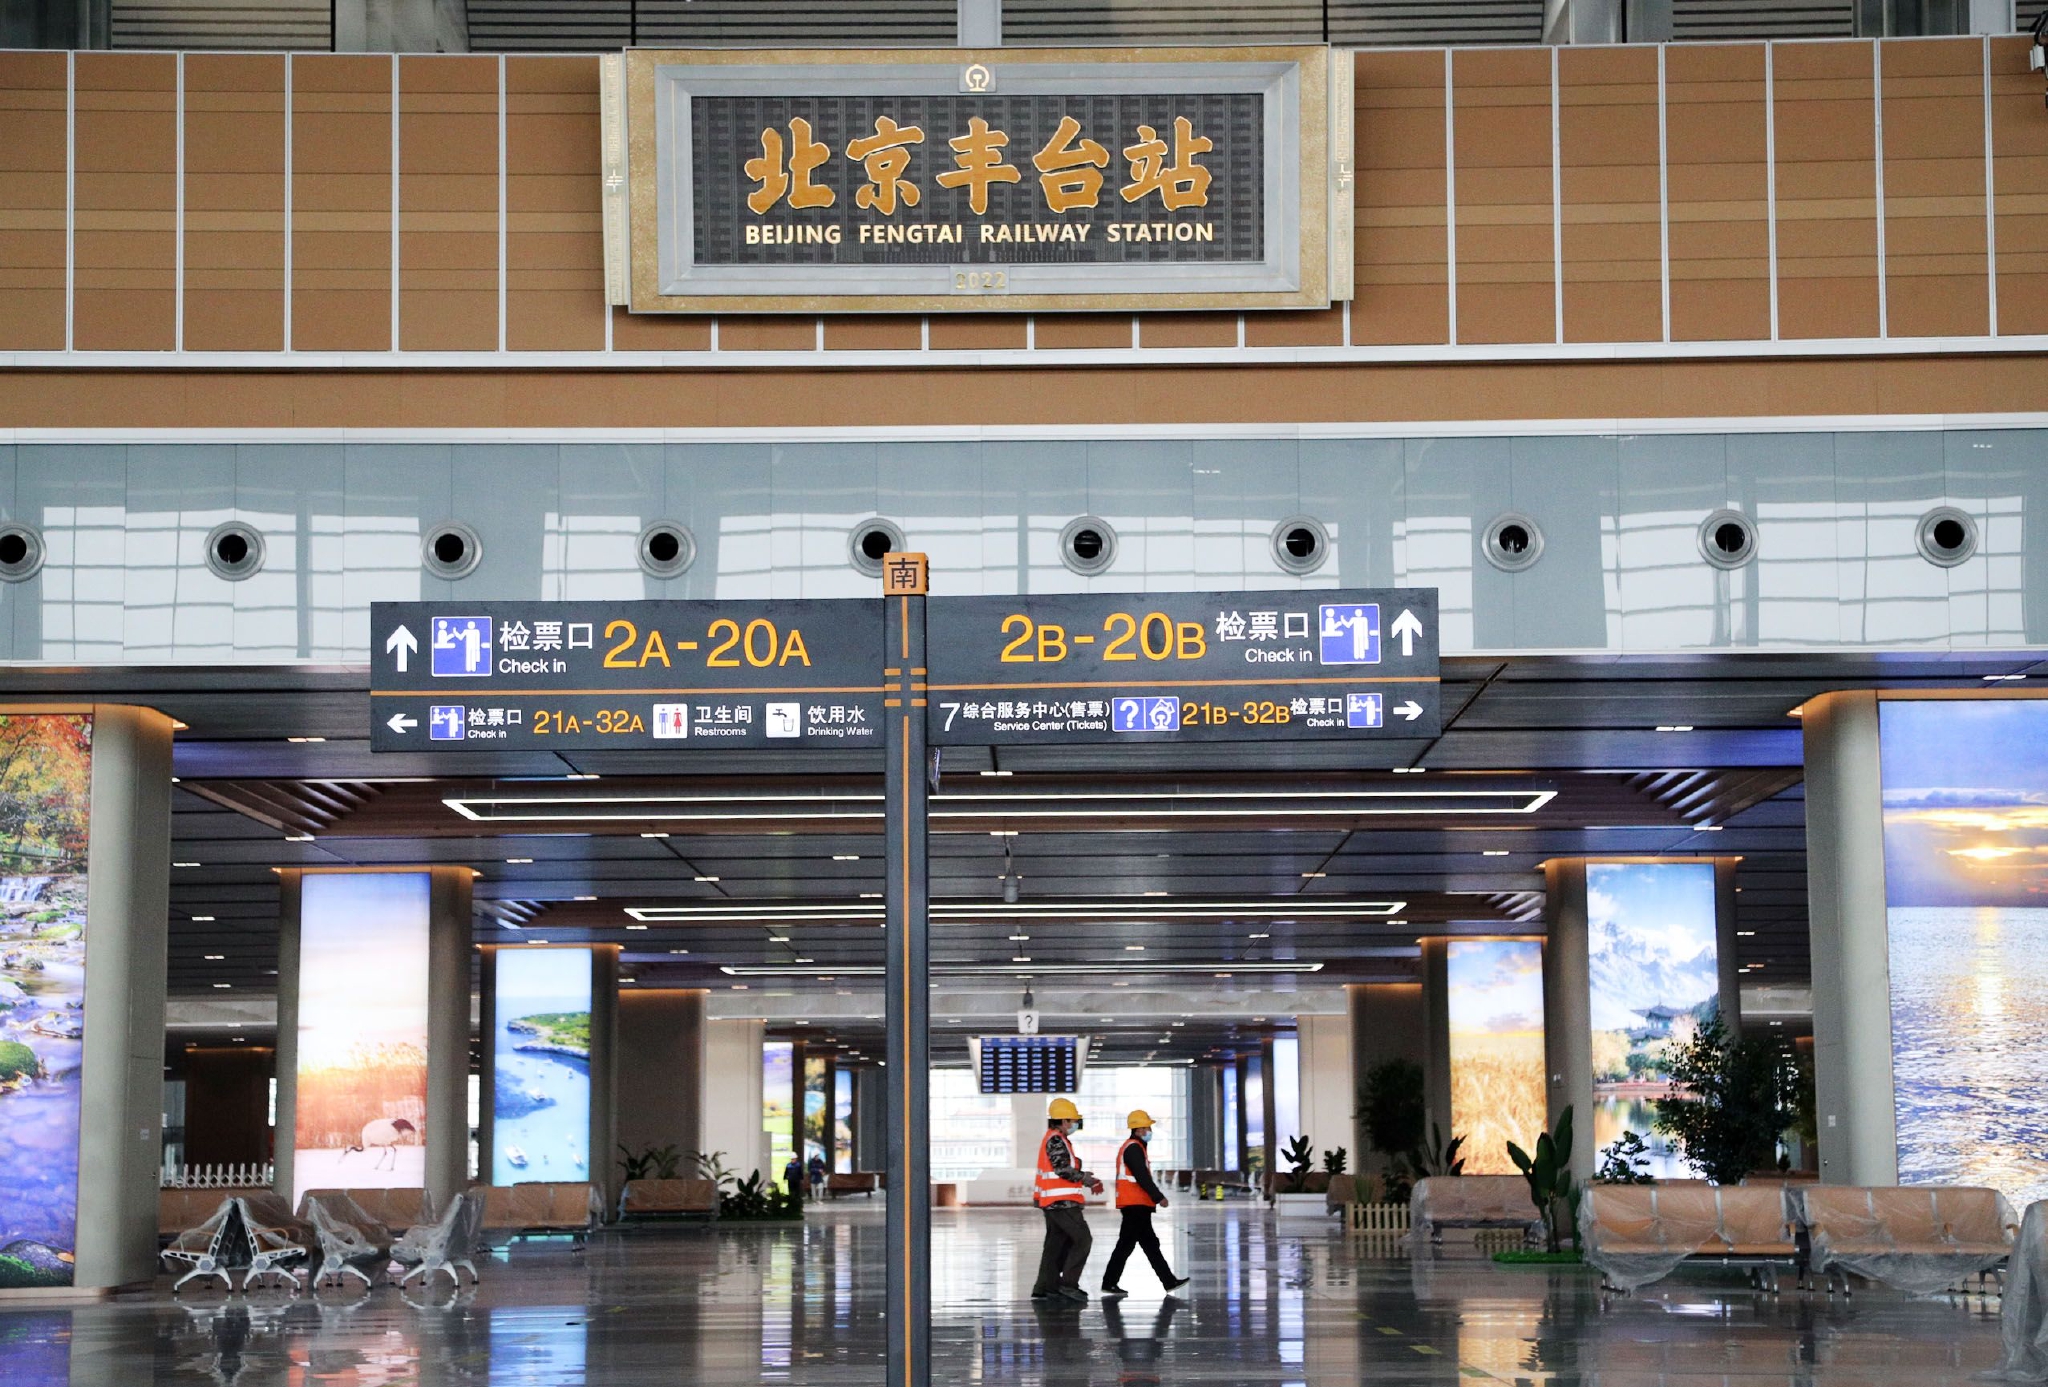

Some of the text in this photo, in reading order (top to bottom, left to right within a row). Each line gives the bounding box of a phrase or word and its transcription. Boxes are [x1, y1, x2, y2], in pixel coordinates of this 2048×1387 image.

[744, 116, 1214, 216] 北京丰台站
[745, 222, 1214, 245] BEIJING FENGTAI RAILWAY STATION
[955, 272, 1006, 290] 2022
[888, 557, 919, 589] 南
[1214, 610, 1310, 643] 检票口
[499, 620, 594, 653] 检票口
[498, 657, 567, 674] Check in
[1244, 647, 1313, 665] Check in
[693, 704, 754, 725] 卫生间
[807, 705, 866, 724] 饮用水
[1290, 697, 1344, 716] 检票口
[467, 707, 523, 728] 检票口
[939, 702, 961, 732] 7
[993, 718, 1108, 732] Service Center (Tickets)
[1306, 717, 1345, 727] Check in
[467, 729, 507, 739] Check in
[694, 726, 747, 737] Restrooms
[807, 726, 874, 738] Drinking Water
